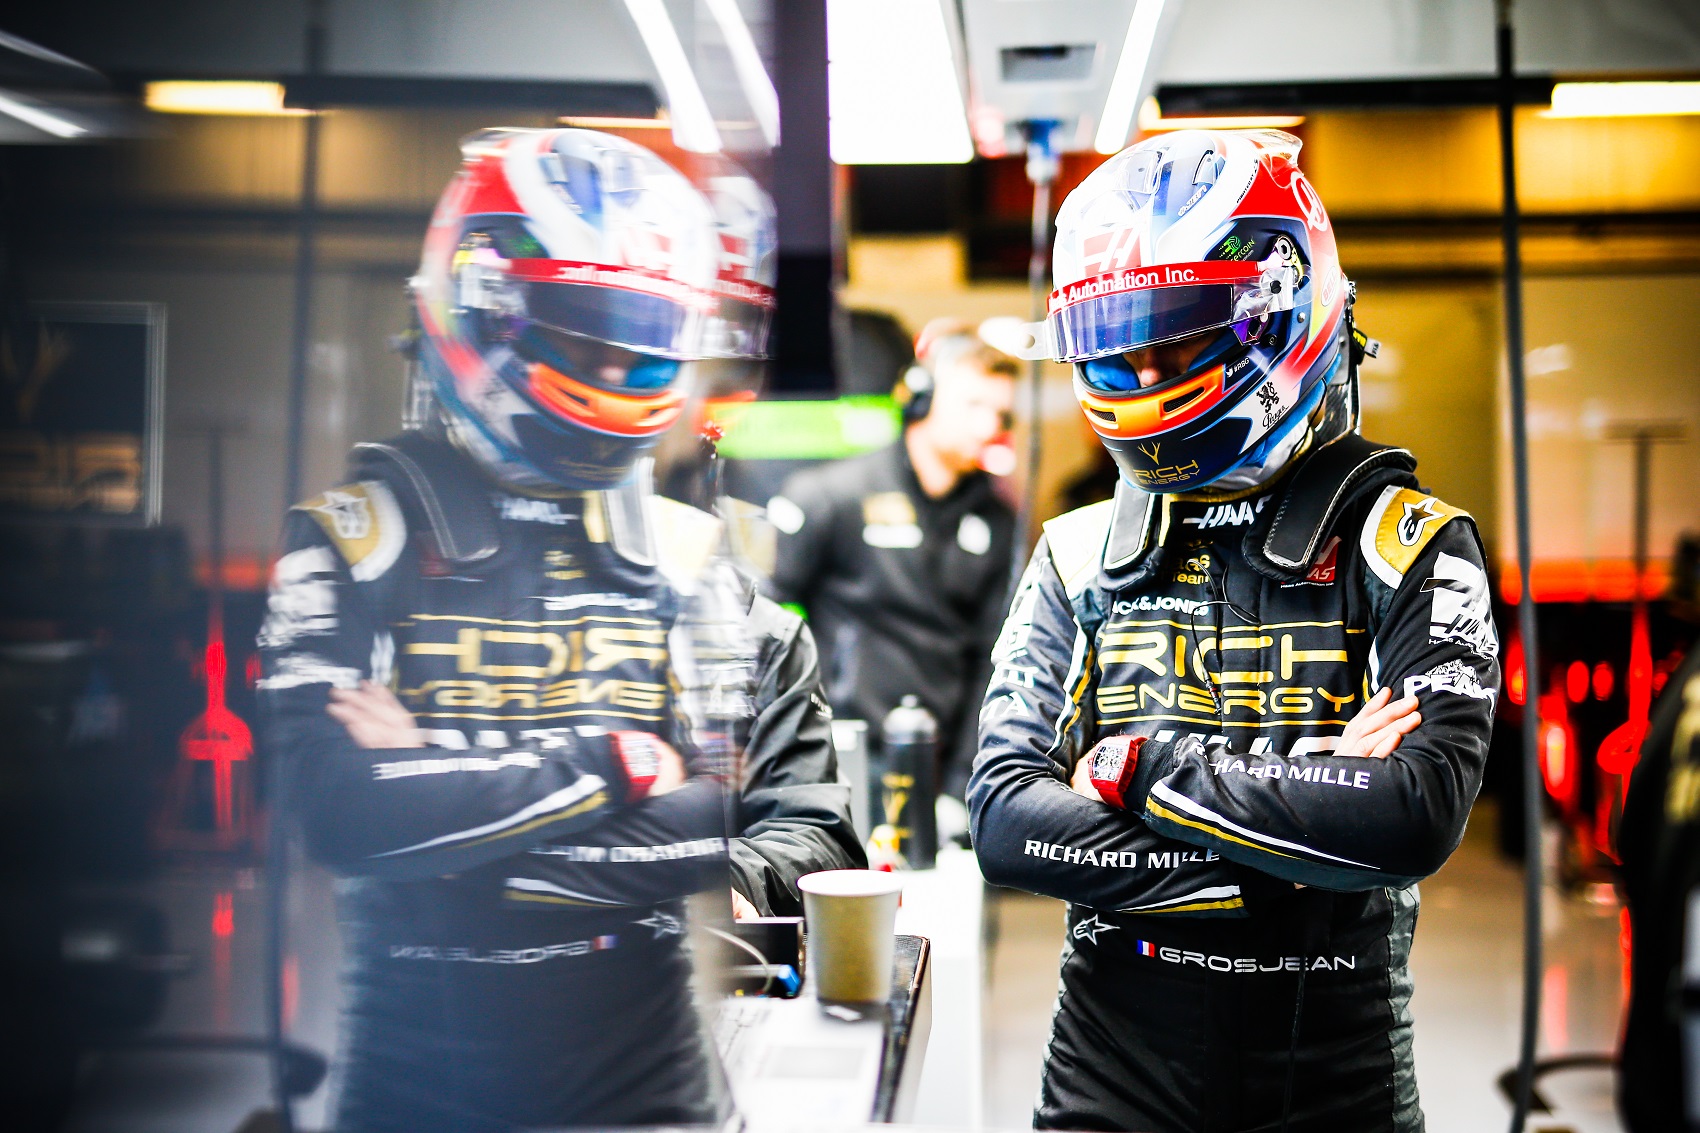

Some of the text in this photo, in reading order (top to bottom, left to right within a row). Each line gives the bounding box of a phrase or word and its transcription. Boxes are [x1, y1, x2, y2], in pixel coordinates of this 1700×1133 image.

[1069, 271, 1159, 303] Automation
[1166, 266, 1200, 283] Inc.
[1133, 459, 1199, 480] RICH
[1139, 469, 1200, 485] ENERGY
[1098, 631, 1349, 684] RICH
[1096, 683, 1355, 715] ENERGY
[1288, 765, 1371, 790] MILLE
[1024, 839, 1137, 869] RICHARD
[1159, 946, 1355, 973] GROSJEAN
